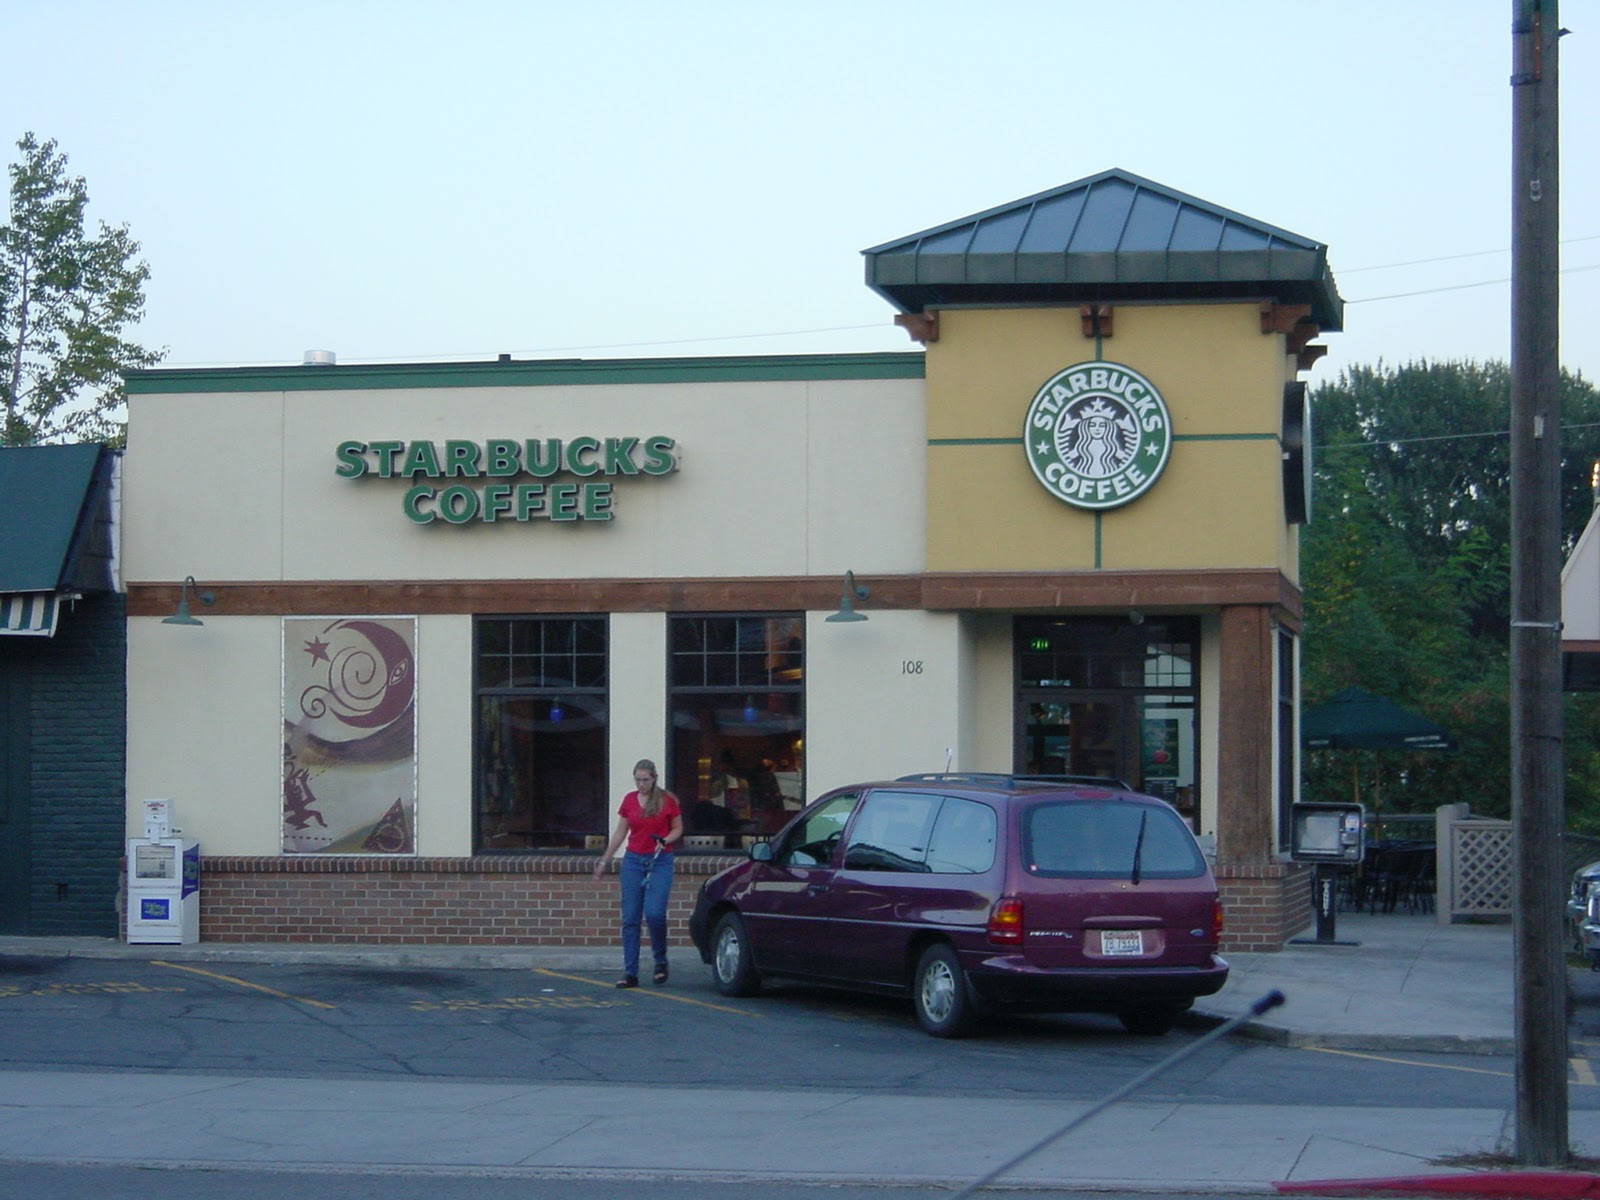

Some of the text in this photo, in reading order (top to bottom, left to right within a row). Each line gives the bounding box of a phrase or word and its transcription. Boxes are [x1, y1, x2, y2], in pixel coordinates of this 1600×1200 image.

[1033, 370, 1163, 433] STARBUCKS
[335, 436, 677, 479] STARBUCKS
[1045, 463, 1146, 501] COFFEE
[402, 483, 614, 525] COFFEE
[902, 660, 923, 674] 108
